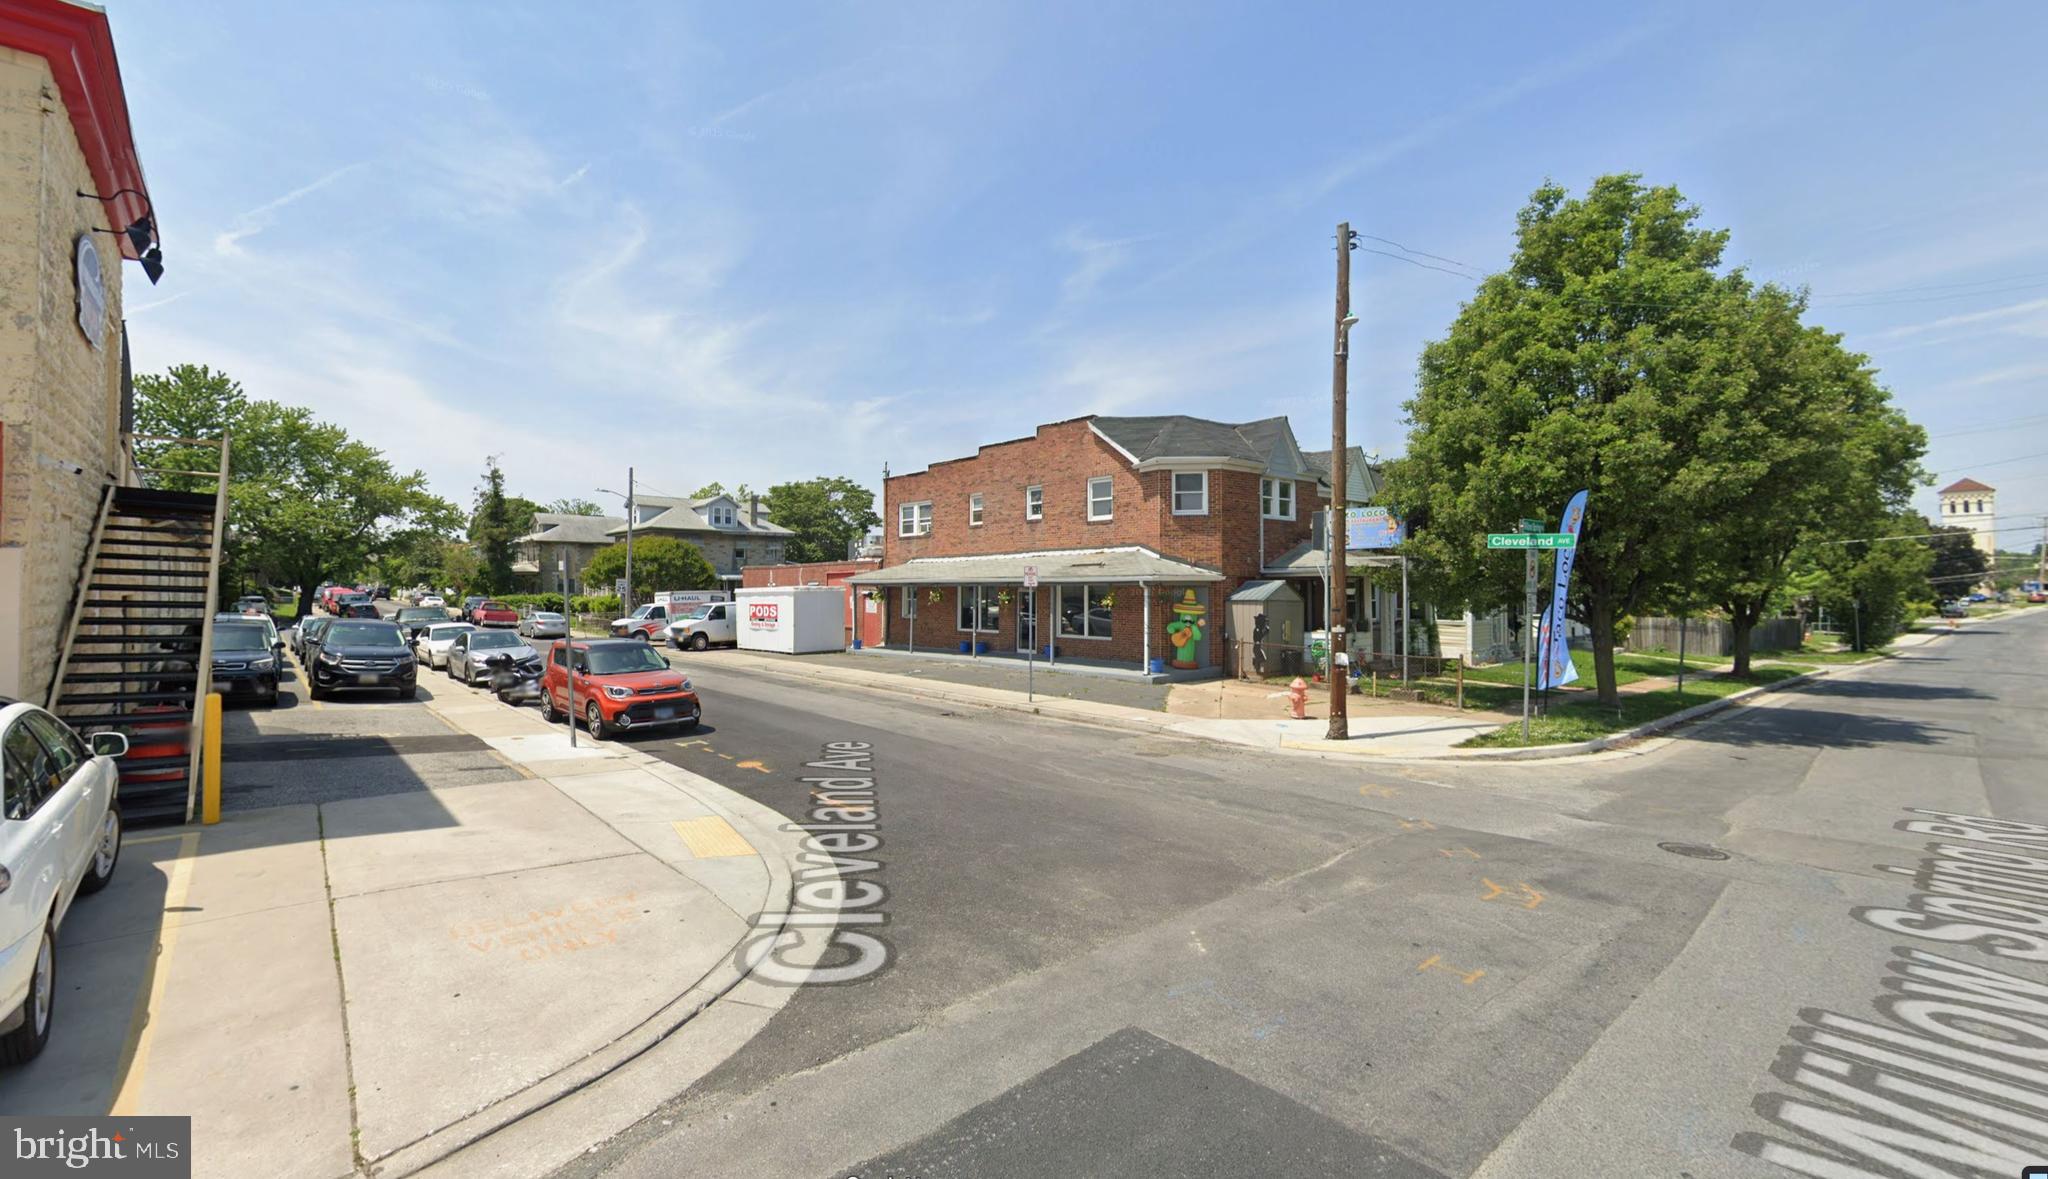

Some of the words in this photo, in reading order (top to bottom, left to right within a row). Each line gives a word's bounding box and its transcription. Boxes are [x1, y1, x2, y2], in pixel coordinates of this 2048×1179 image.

[1361, 509, 1386, 517] LOCO
[1492, 536, 1554, 546] Cleveland
[750, 604, 777, 618] PODS
